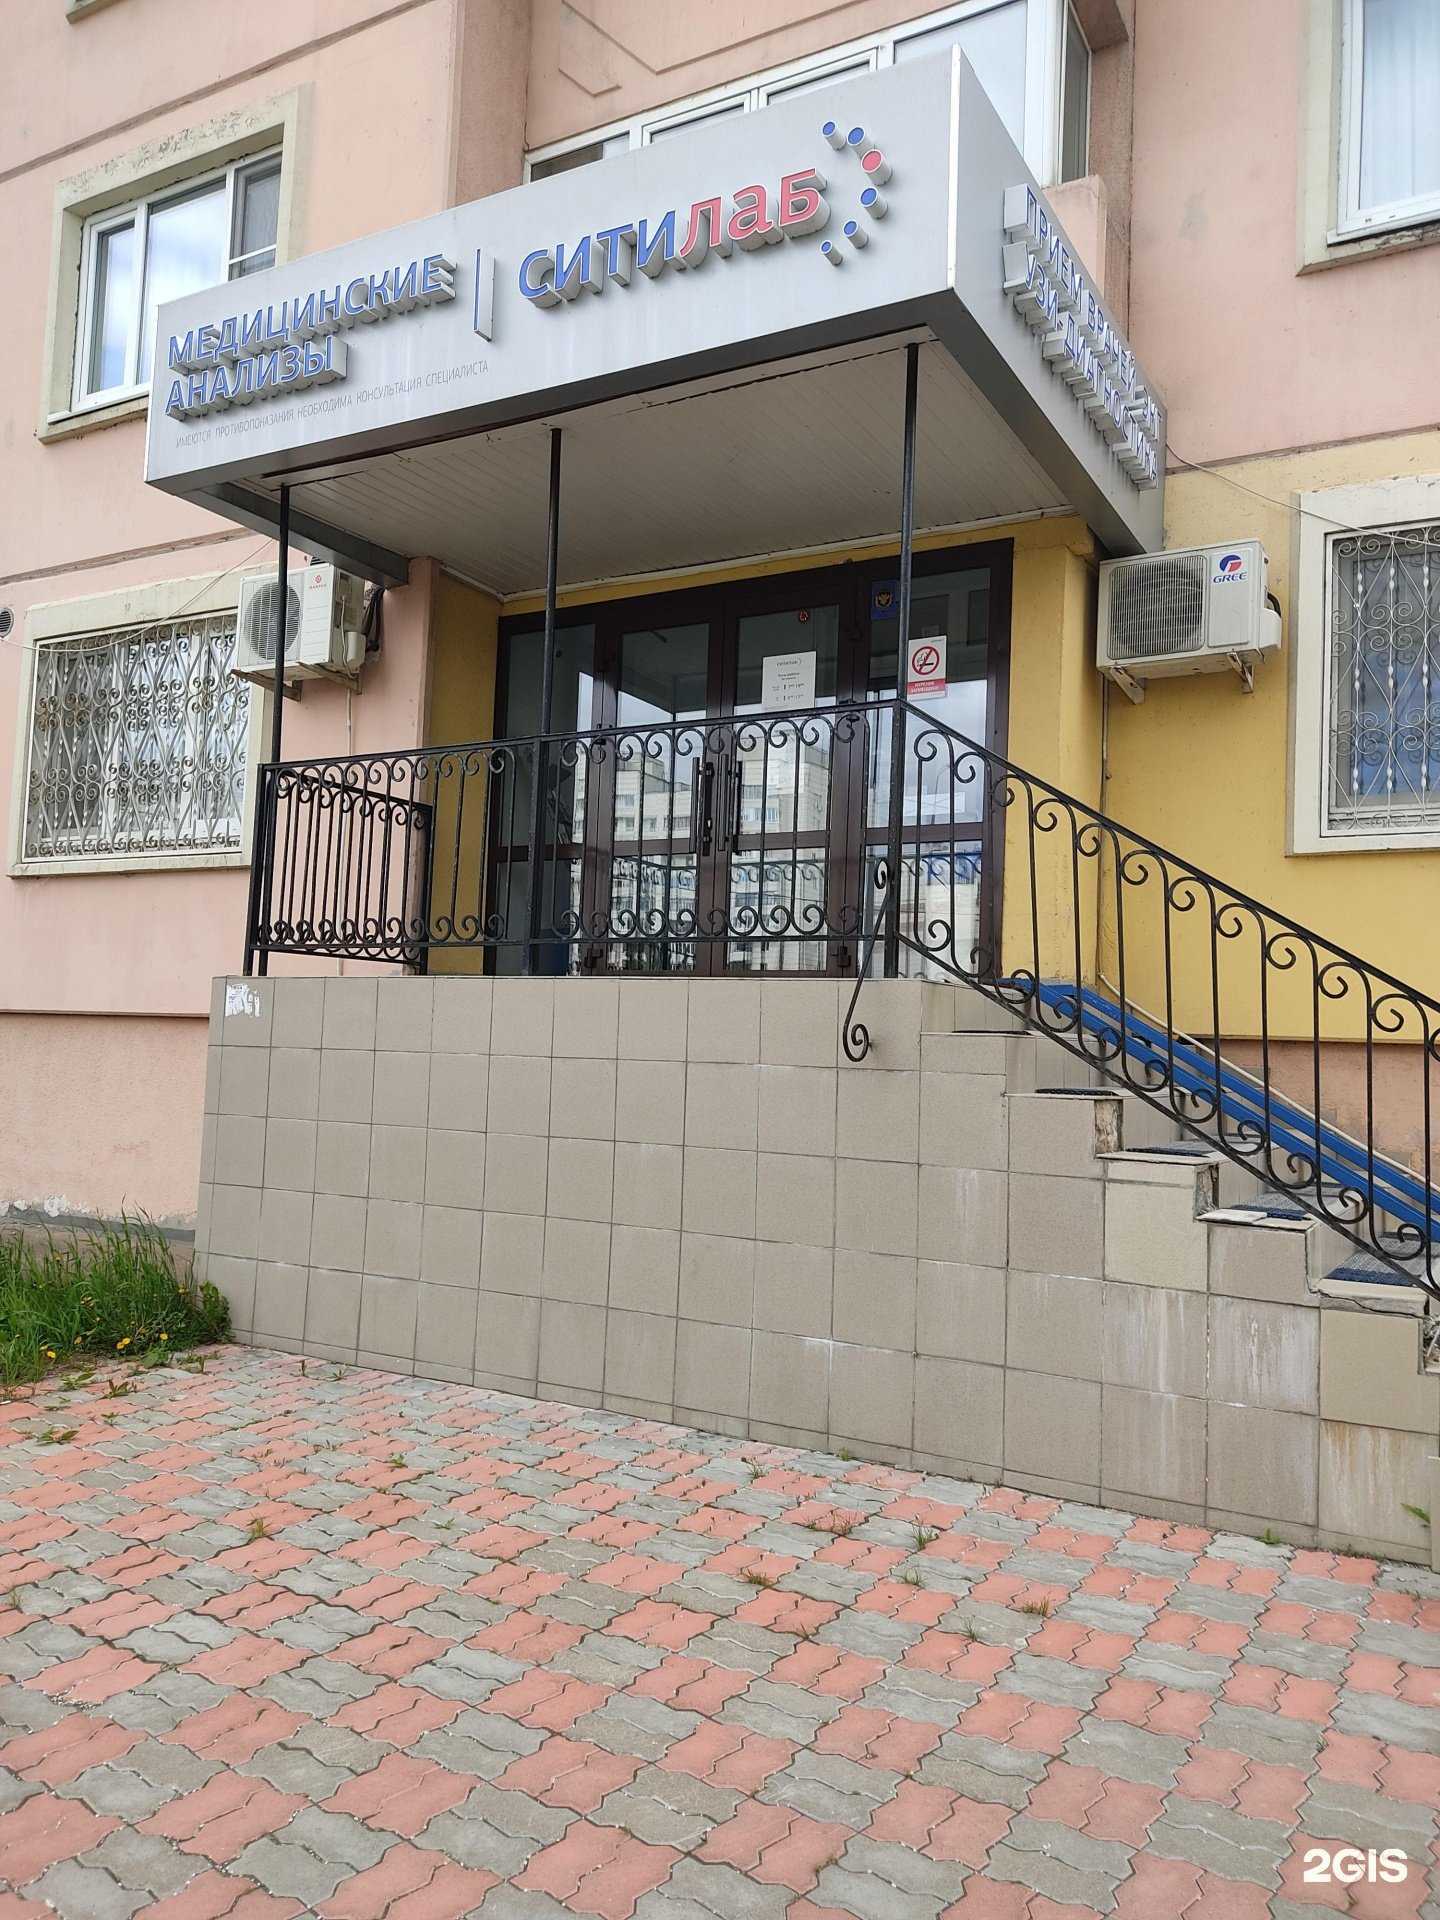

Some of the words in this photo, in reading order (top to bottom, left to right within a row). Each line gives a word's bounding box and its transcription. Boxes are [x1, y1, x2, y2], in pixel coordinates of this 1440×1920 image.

[1026, 184, 1084, 314] ПРИЕМ
[167, 253, 444, 369] МЕДИЦИНСКИЕ
[164, 334, 334, 415] АНАЛИЗЫ
[176, 428, 211, 448] ИМЕЮТСЯ
[297, 394, 353, 420] НЕОБХОДИМА
[356, 378, 422, 405] КОНСУЛЬТАЦИЯ
[425, 359, 489, 387] СПЕЦИАЛИСТА
[1212, 571, 1248, 584] GREE
